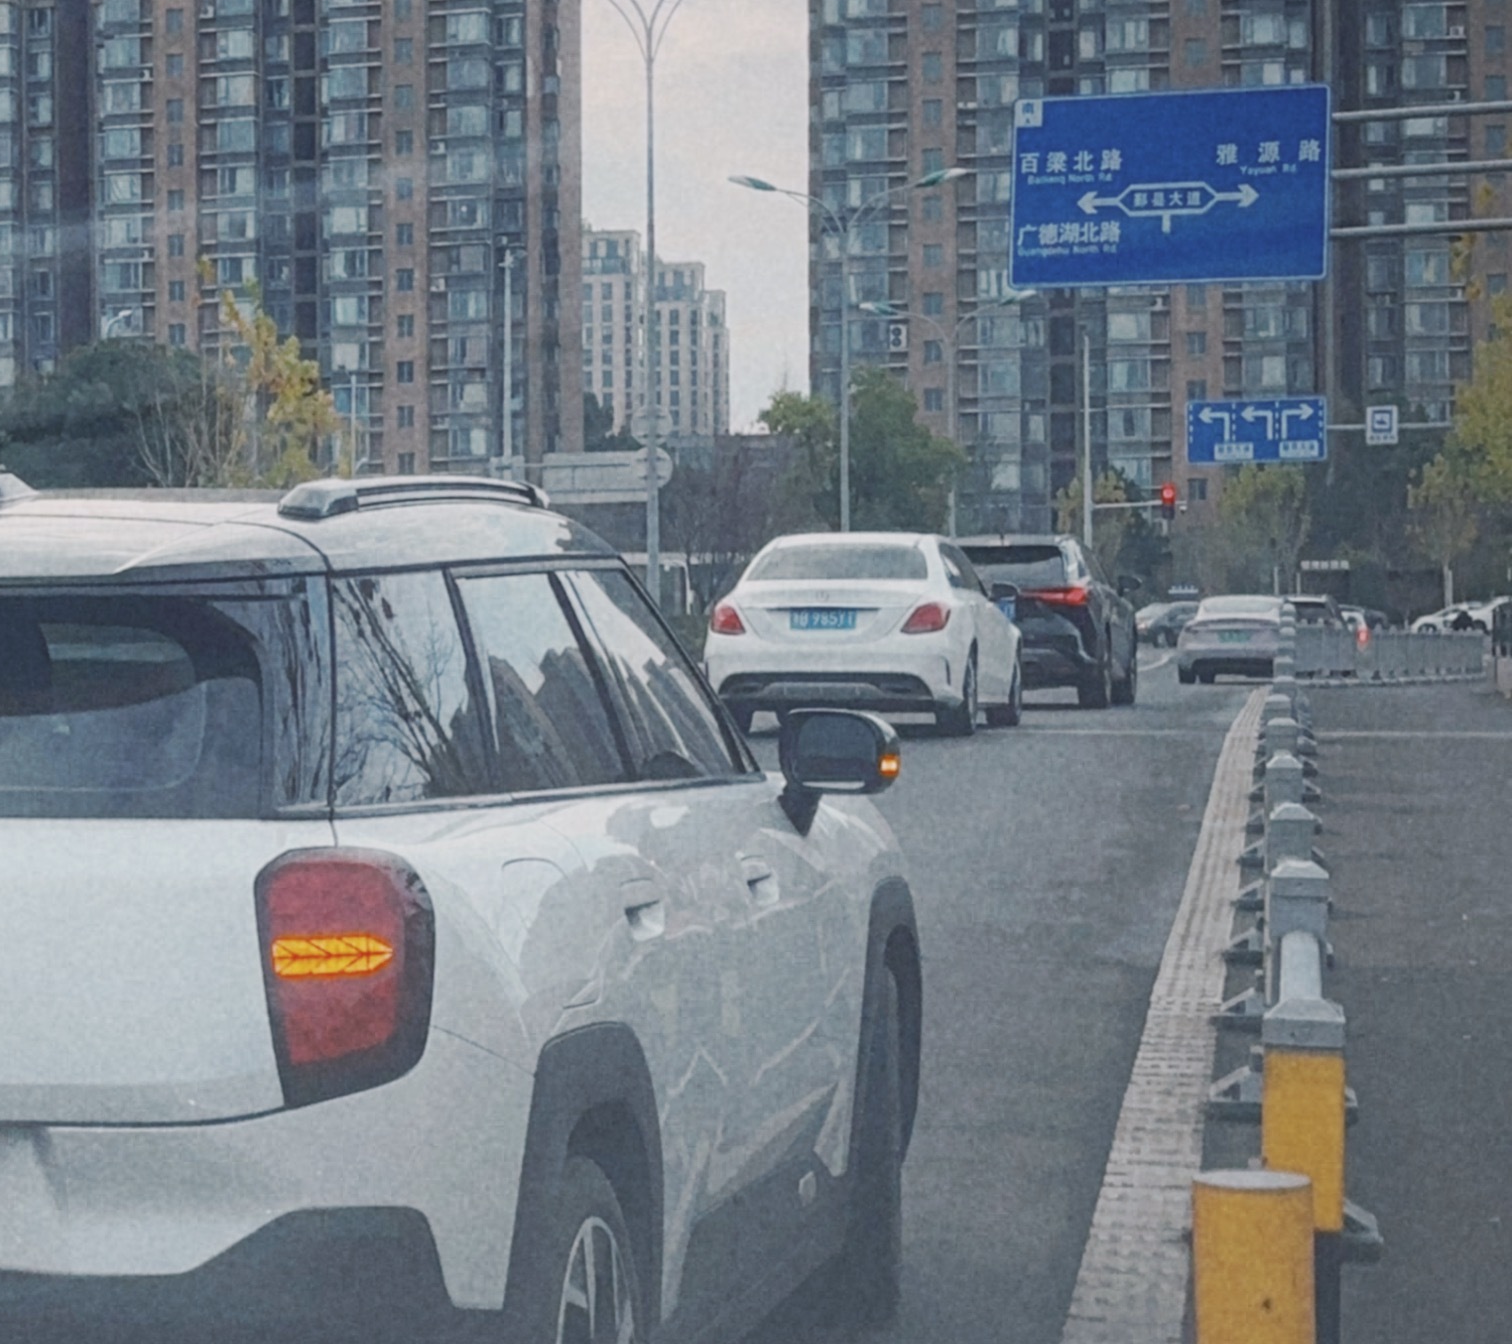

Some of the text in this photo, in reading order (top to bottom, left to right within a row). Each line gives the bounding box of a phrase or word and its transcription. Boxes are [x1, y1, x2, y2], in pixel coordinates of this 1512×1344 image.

[1019, 148, 1122, 174] 百梁北路
[1017, 220, 1121, 246] 广德湖北路
